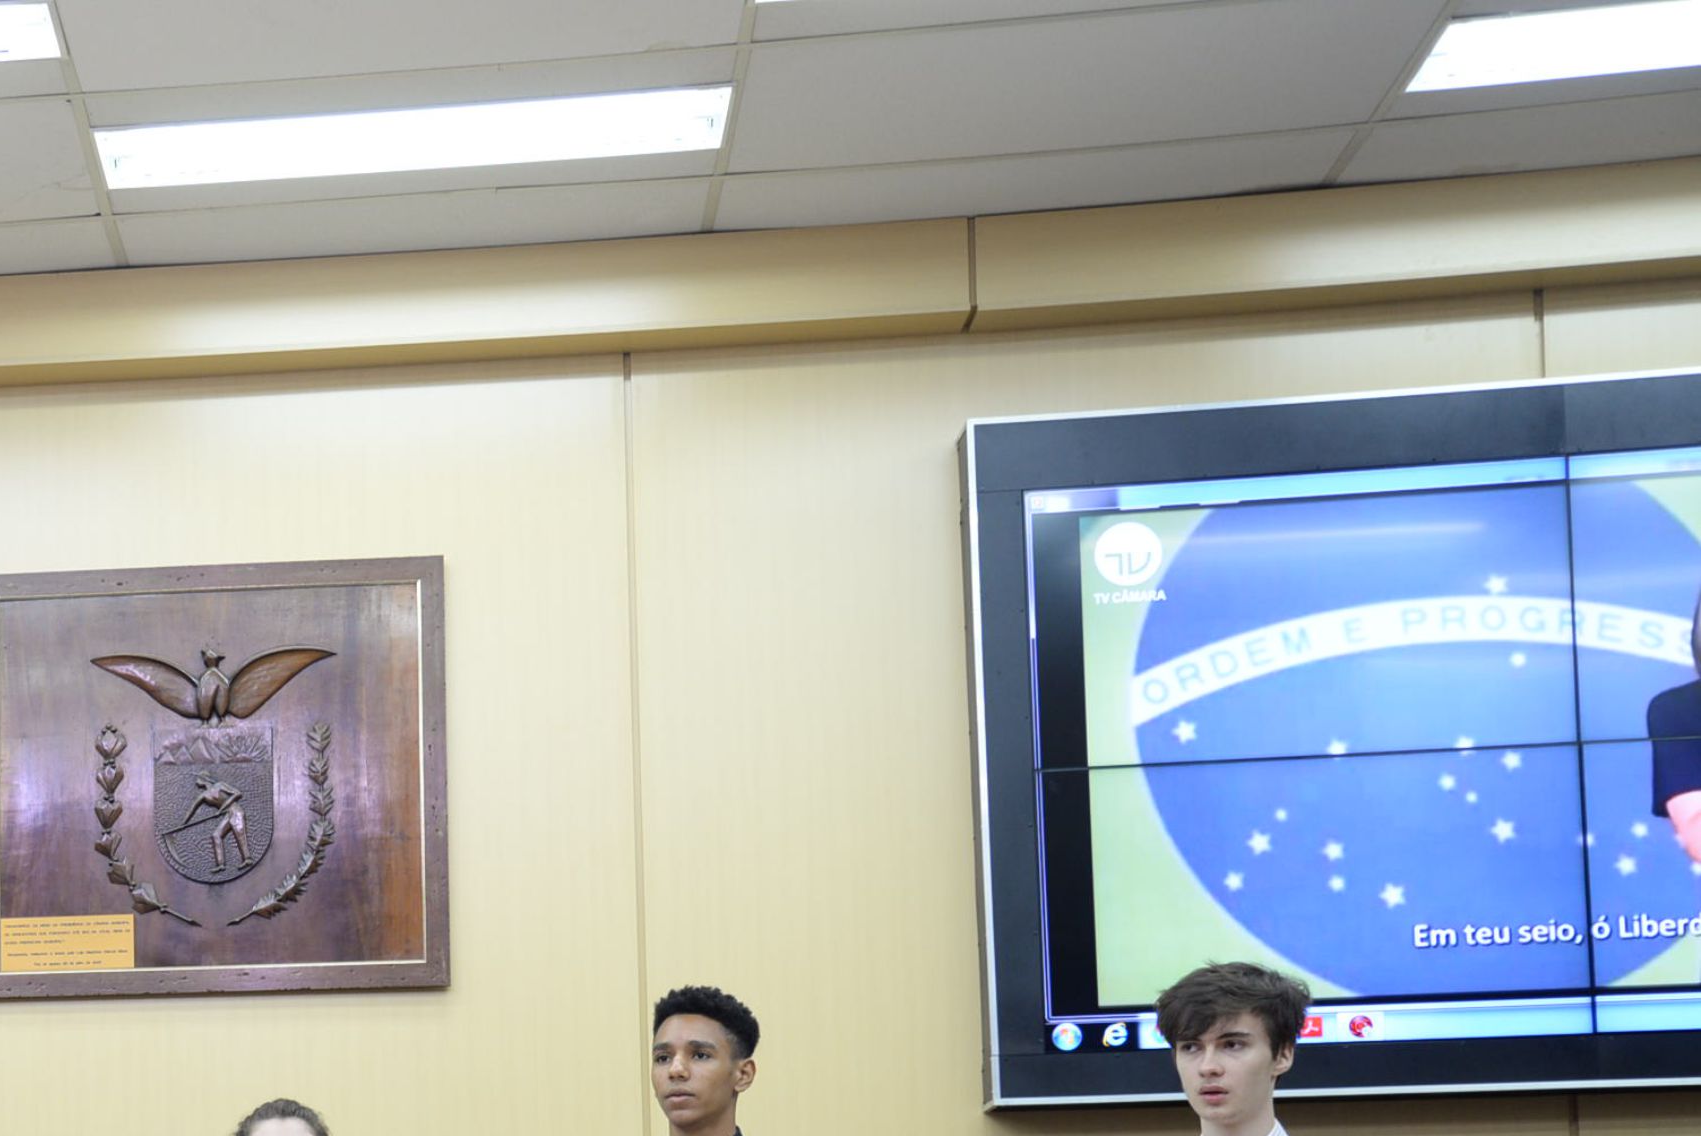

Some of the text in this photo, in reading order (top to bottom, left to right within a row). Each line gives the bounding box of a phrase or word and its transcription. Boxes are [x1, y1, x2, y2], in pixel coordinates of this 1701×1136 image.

[1093, 589, 1167, 605] TV CÂMARA
[1142, 627, 1311, 704] ORDEM
[1343, 617, 1367, 644] E
[1413, 923, 1457, 948] Em
[1464, 924, 1510, 945] teu
[1518, 919, 1583, 944] seio,
[1592, 915, 1610, 940] ó
